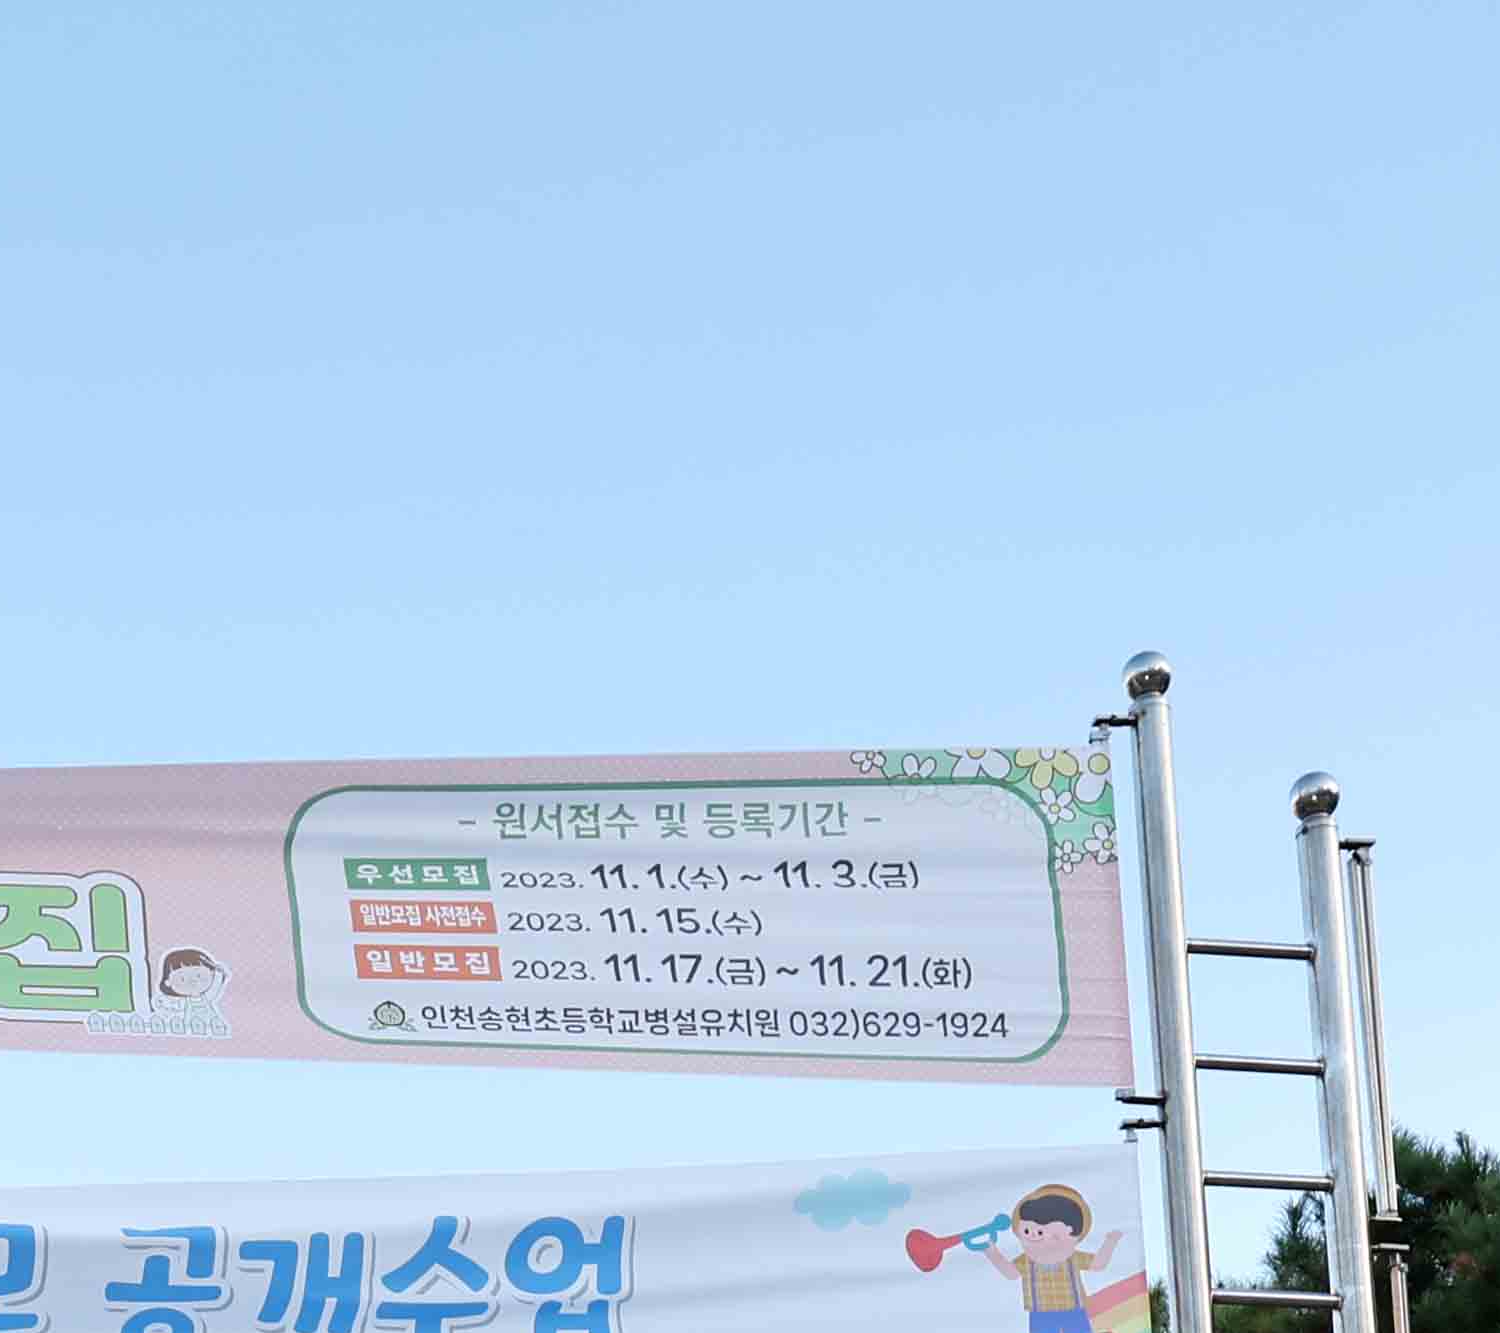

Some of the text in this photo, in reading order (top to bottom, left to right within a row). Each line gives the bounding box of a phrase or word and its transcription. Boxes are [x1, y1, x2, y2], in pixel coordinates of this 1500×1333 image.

[493, 801, 848, 840] 원서접수 및 등록기간
[356, 864, 480, 885] 우선모집
[502, 872, 584, 889] 2023.
[590, 864, 638, 889] 11.
[647, 863, 728, 890] 1.(수)
[774, 860, 821, 888] 11.
[832, 859, 919, 889] 3.(금)
[360, 904, 487, 927] 일반모집 사전접수
[507, 908, 761, 936] 2023. 11. 15.(수)
[366, 950, 491, 975] 일반모집
[512, 960, 595, 981] 2023.
[604, 954, 652, 983] 11.
[661, 953, 766, 986] 17.(금)
[810, 955, 857, 987] 11.
[868, 955, 971, 989] 21.(화)
[421, 1005, 1008, 1039] 인천송현초등학교병설유치원 032)629-1924
